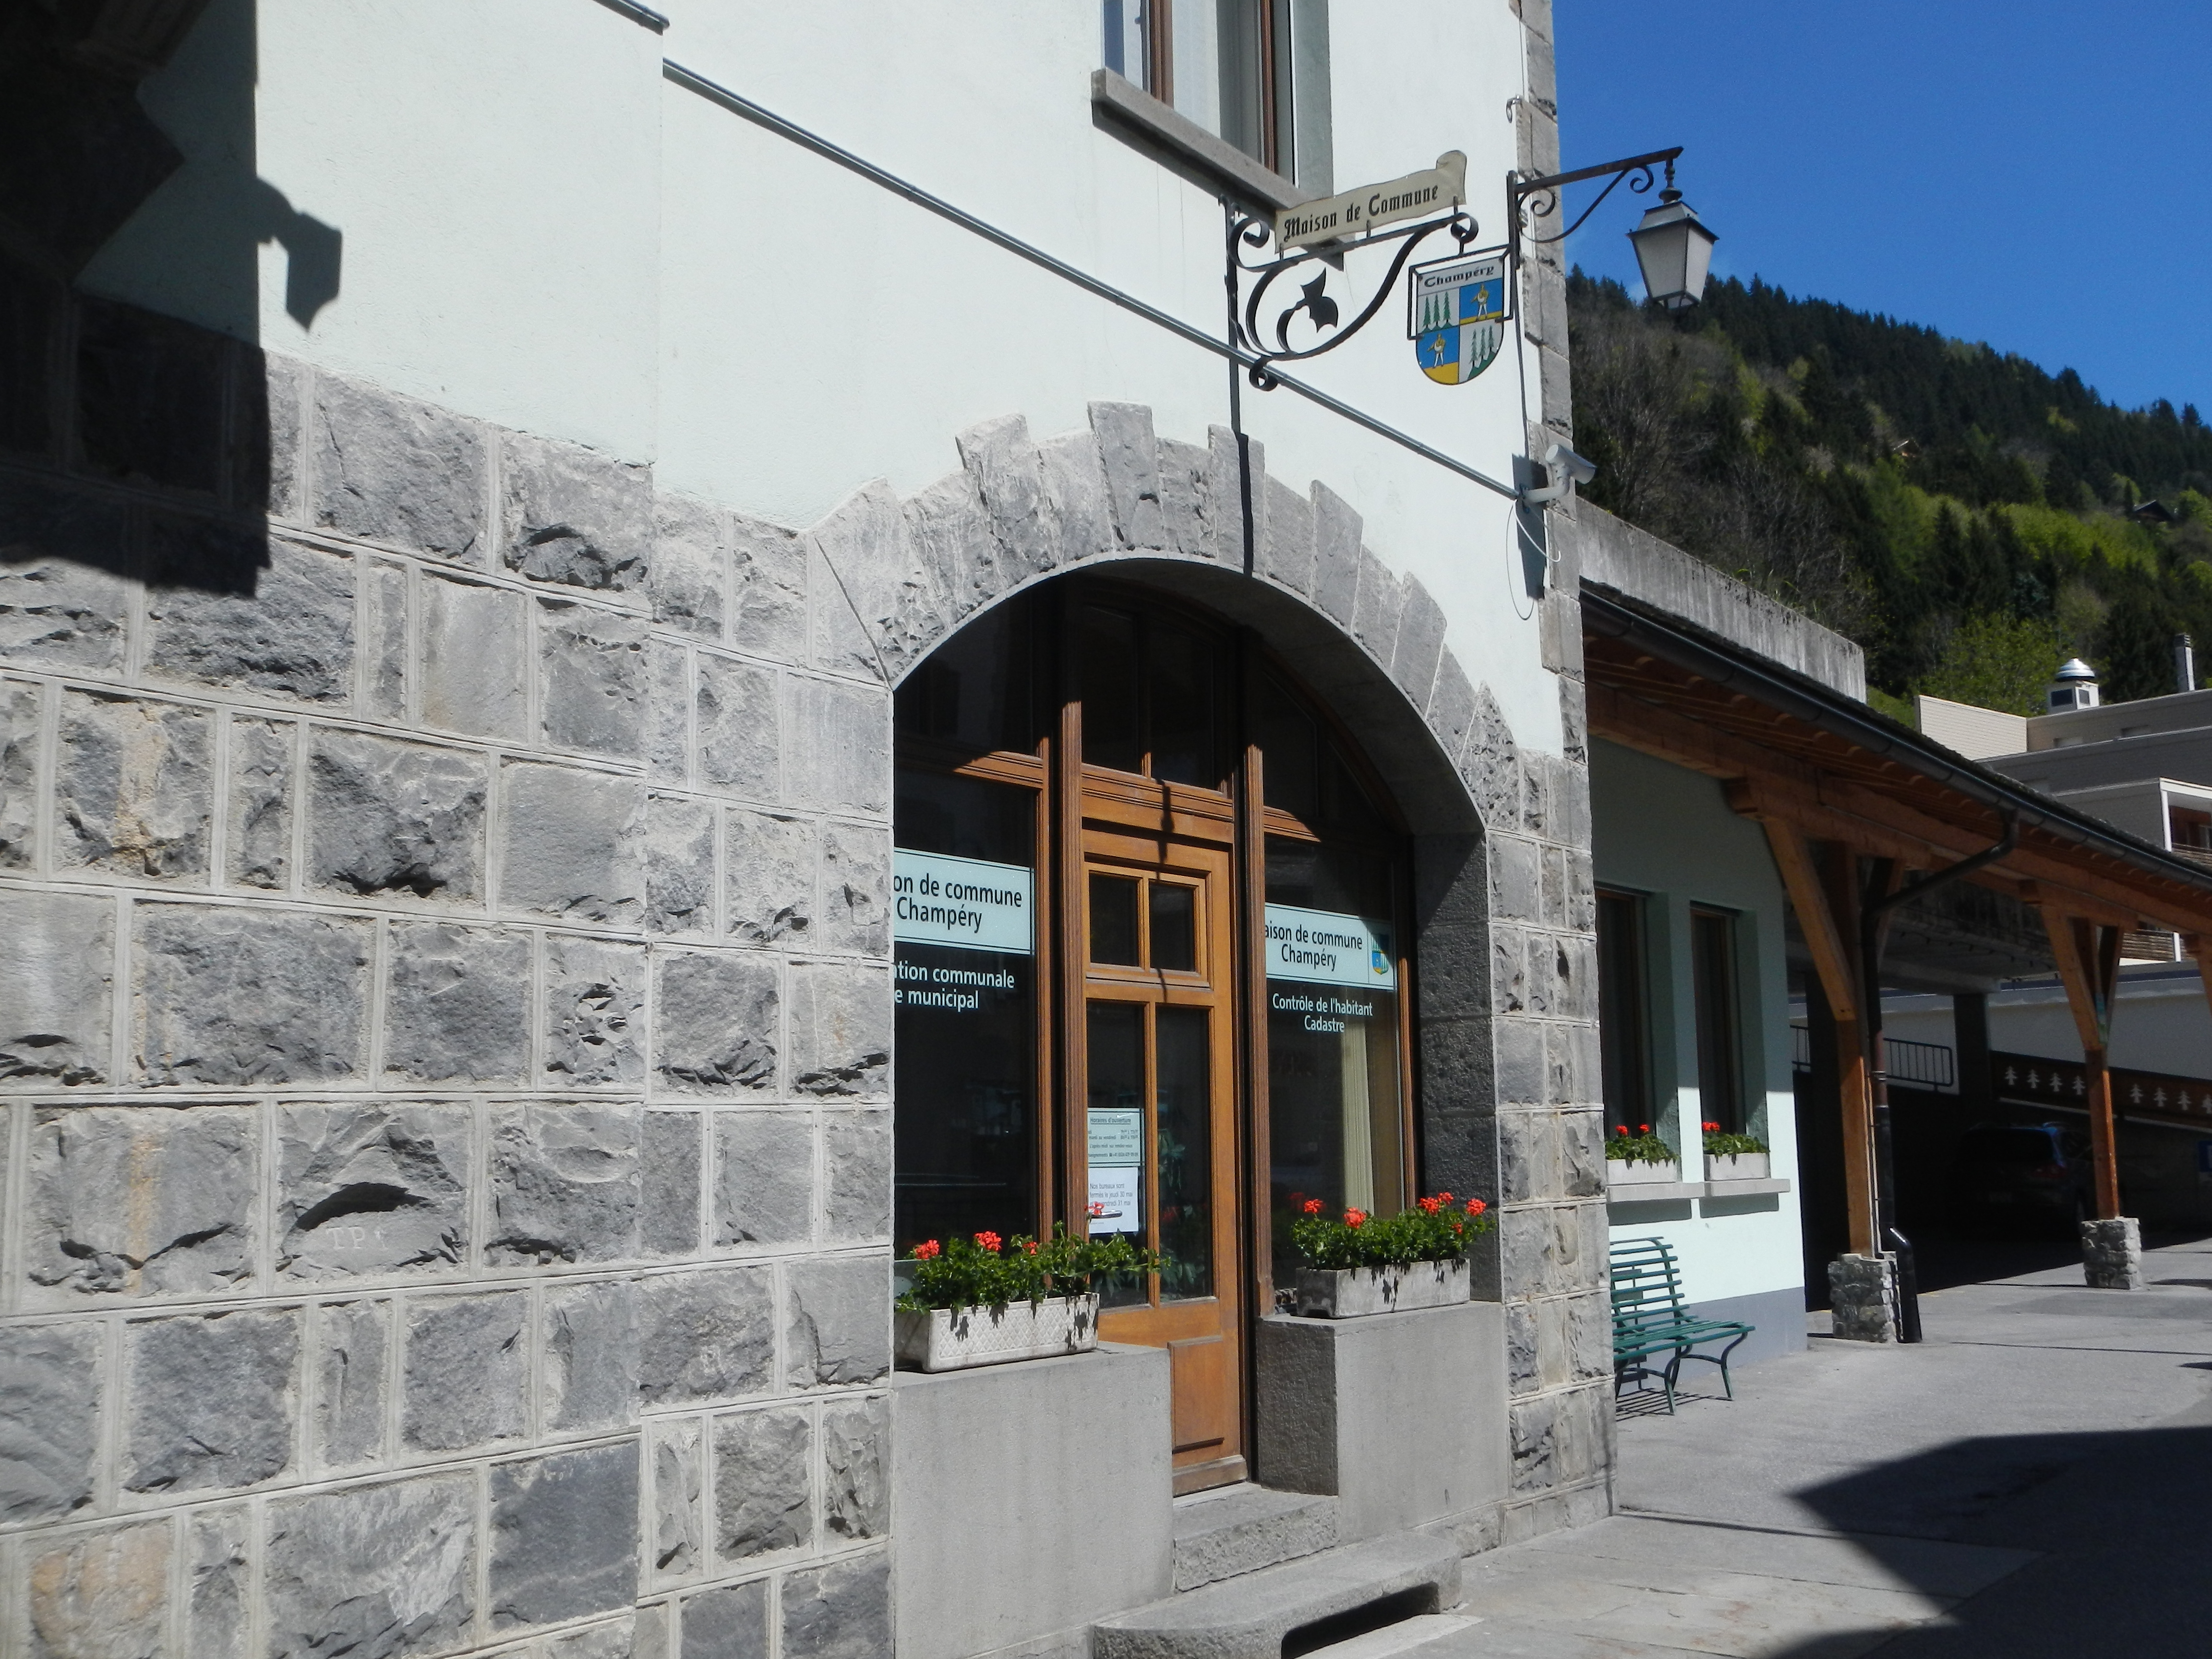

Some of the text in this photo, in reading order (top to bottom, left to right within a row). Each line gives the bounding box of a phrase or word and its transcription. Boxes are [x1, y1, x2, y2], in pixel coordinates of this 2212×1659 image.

[1284, 185, 1438, 242] Maison de Commune
[1424, 266, 1494, 287] Champéry
[920, 873, 939, 897] de
[945, 882, 1022, 908] commune
[897, 896, 982, 934] Champéry
[1296, 924, 1309, 944] de
[1312, 931, 1363, 950] commune
[1281, 944, 1337, 972] Champéry
[933, 968, 1015, 989] communale
[908, 988, 979, 1013] municipal
[1273, 992, 1373, 1016] Contrôle de l'habitant
[1304, 1015, 1345, 1033] Cadastre
